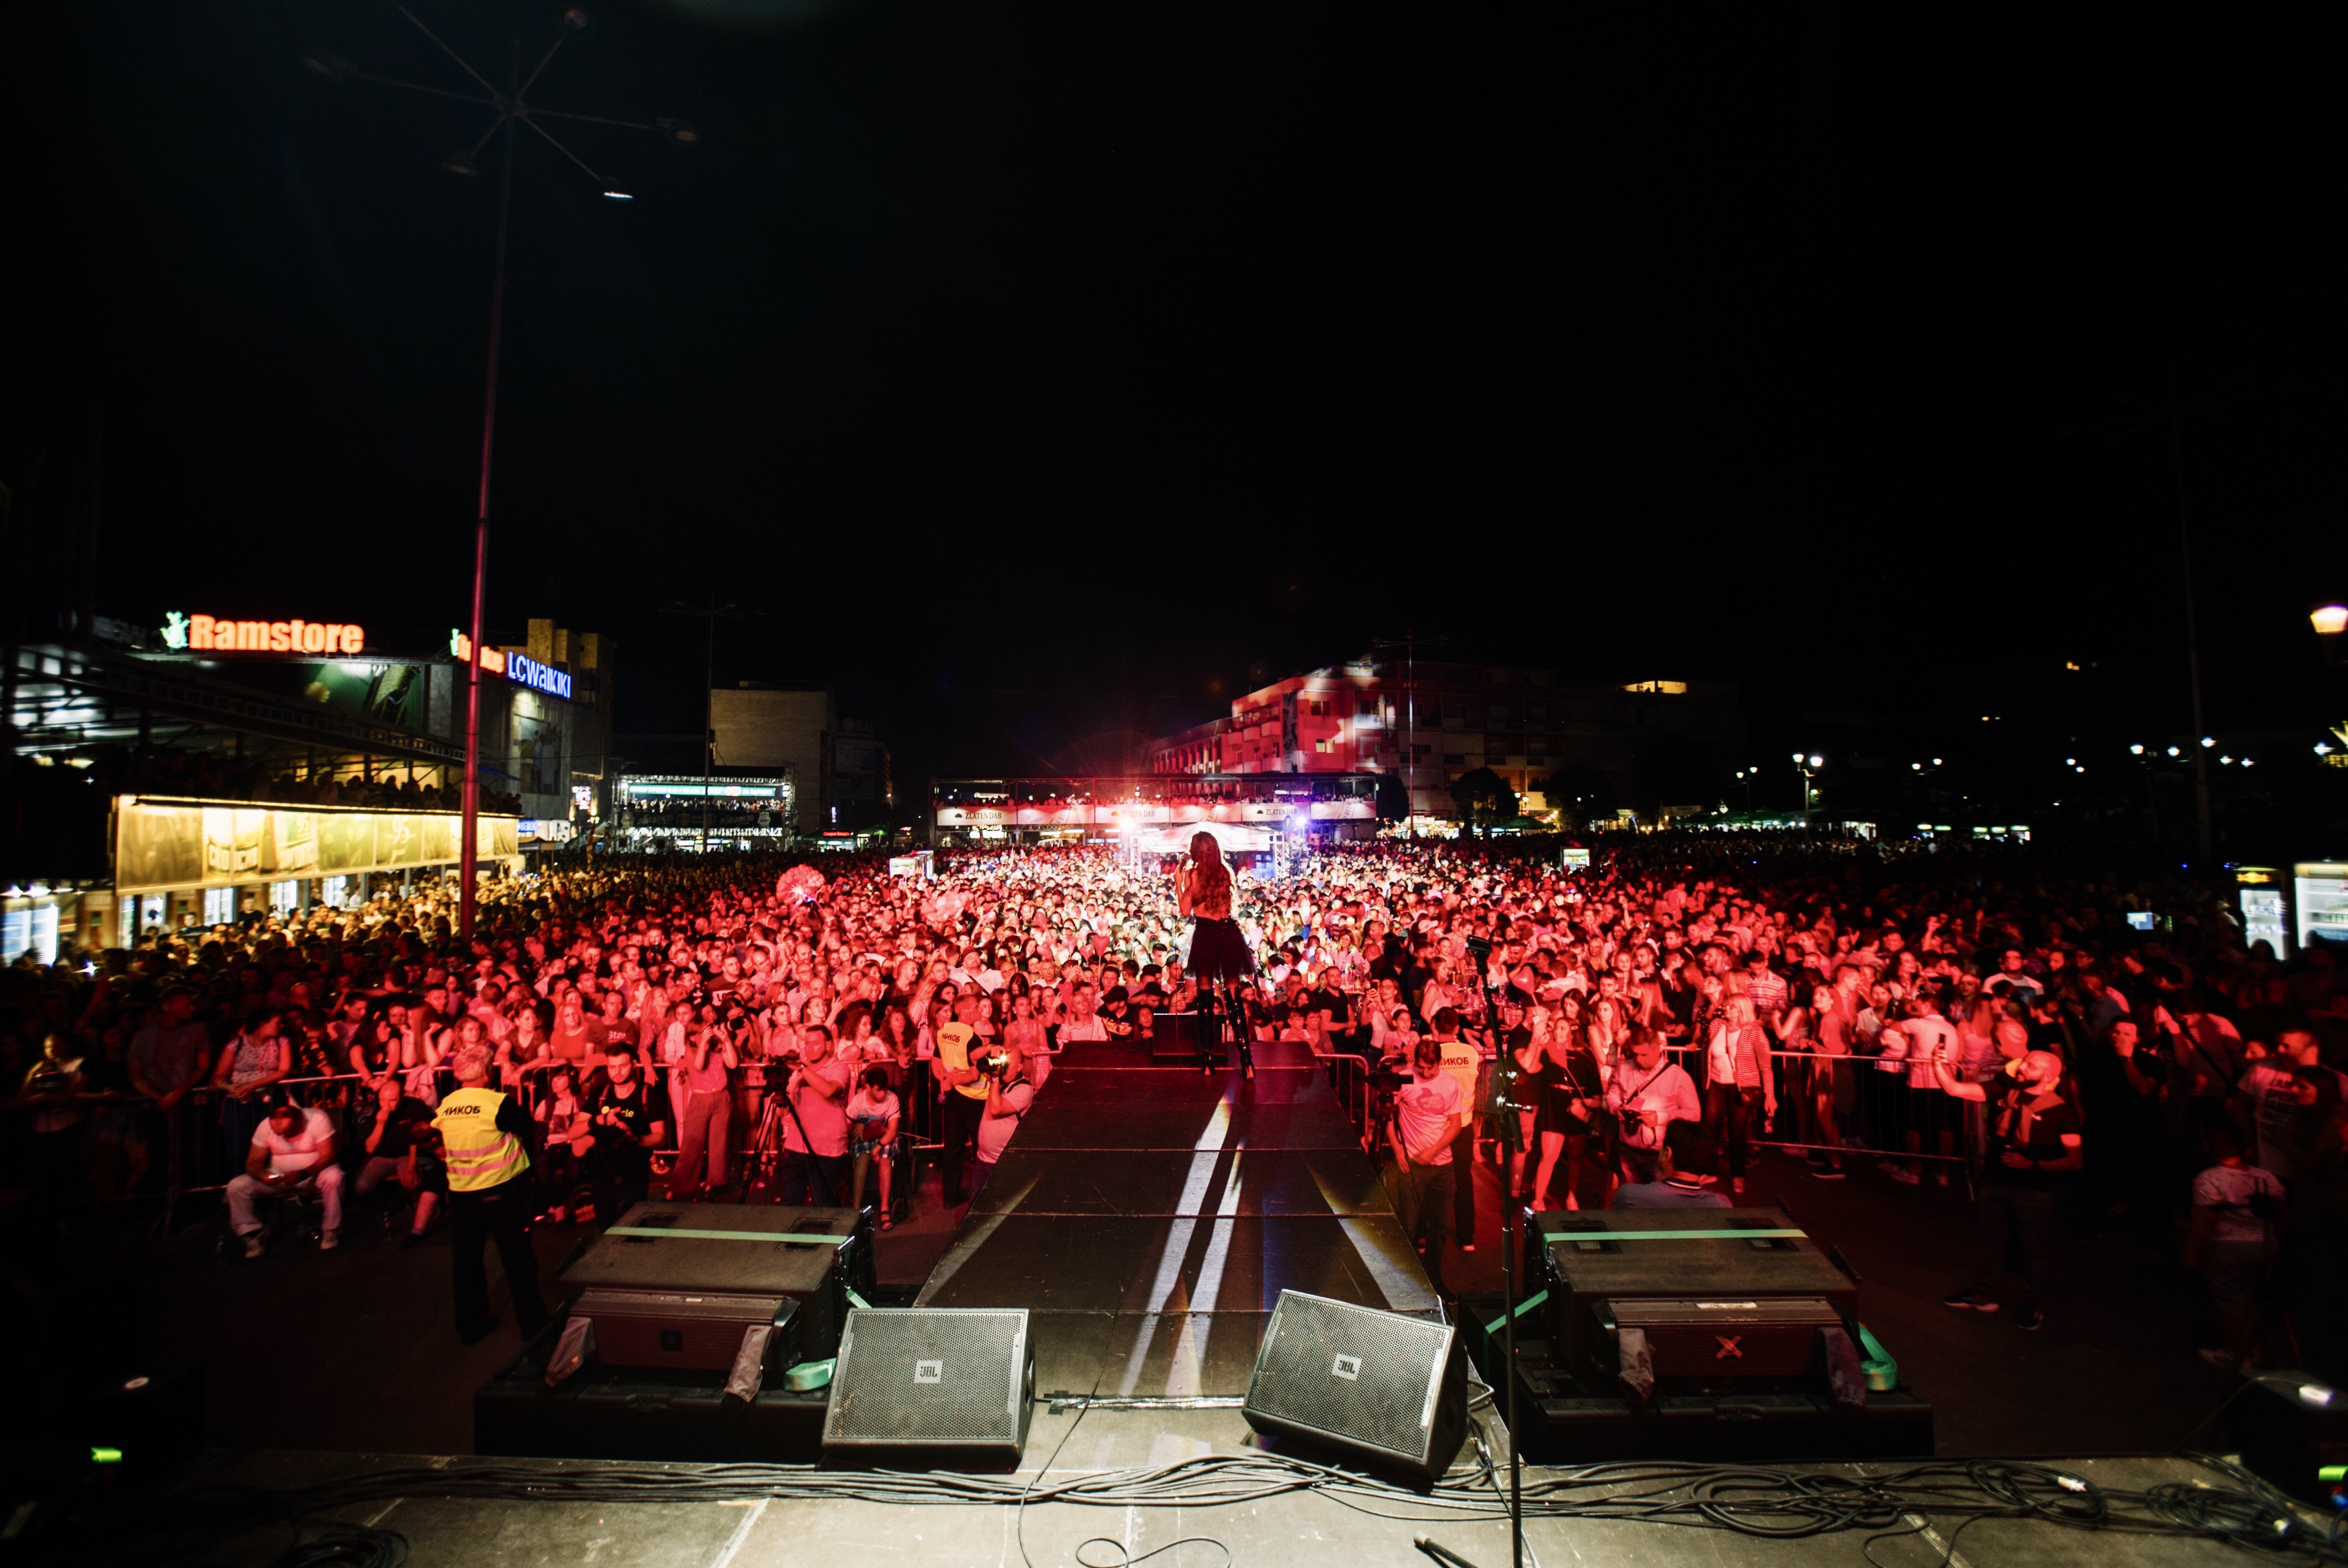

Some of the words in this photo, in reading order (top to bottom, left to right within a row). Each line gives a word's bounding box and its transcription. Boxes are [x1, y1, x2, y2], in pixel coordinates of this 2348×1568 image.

[189, 615, 364, 653] Ramstore
[458, 633, 504, 673] Rastore
[941, 1033, 960, 1043] НИКОБ
[920, 1366, 938, 1377] JBL
[1338, 1360, 1355, 1374] JBL
